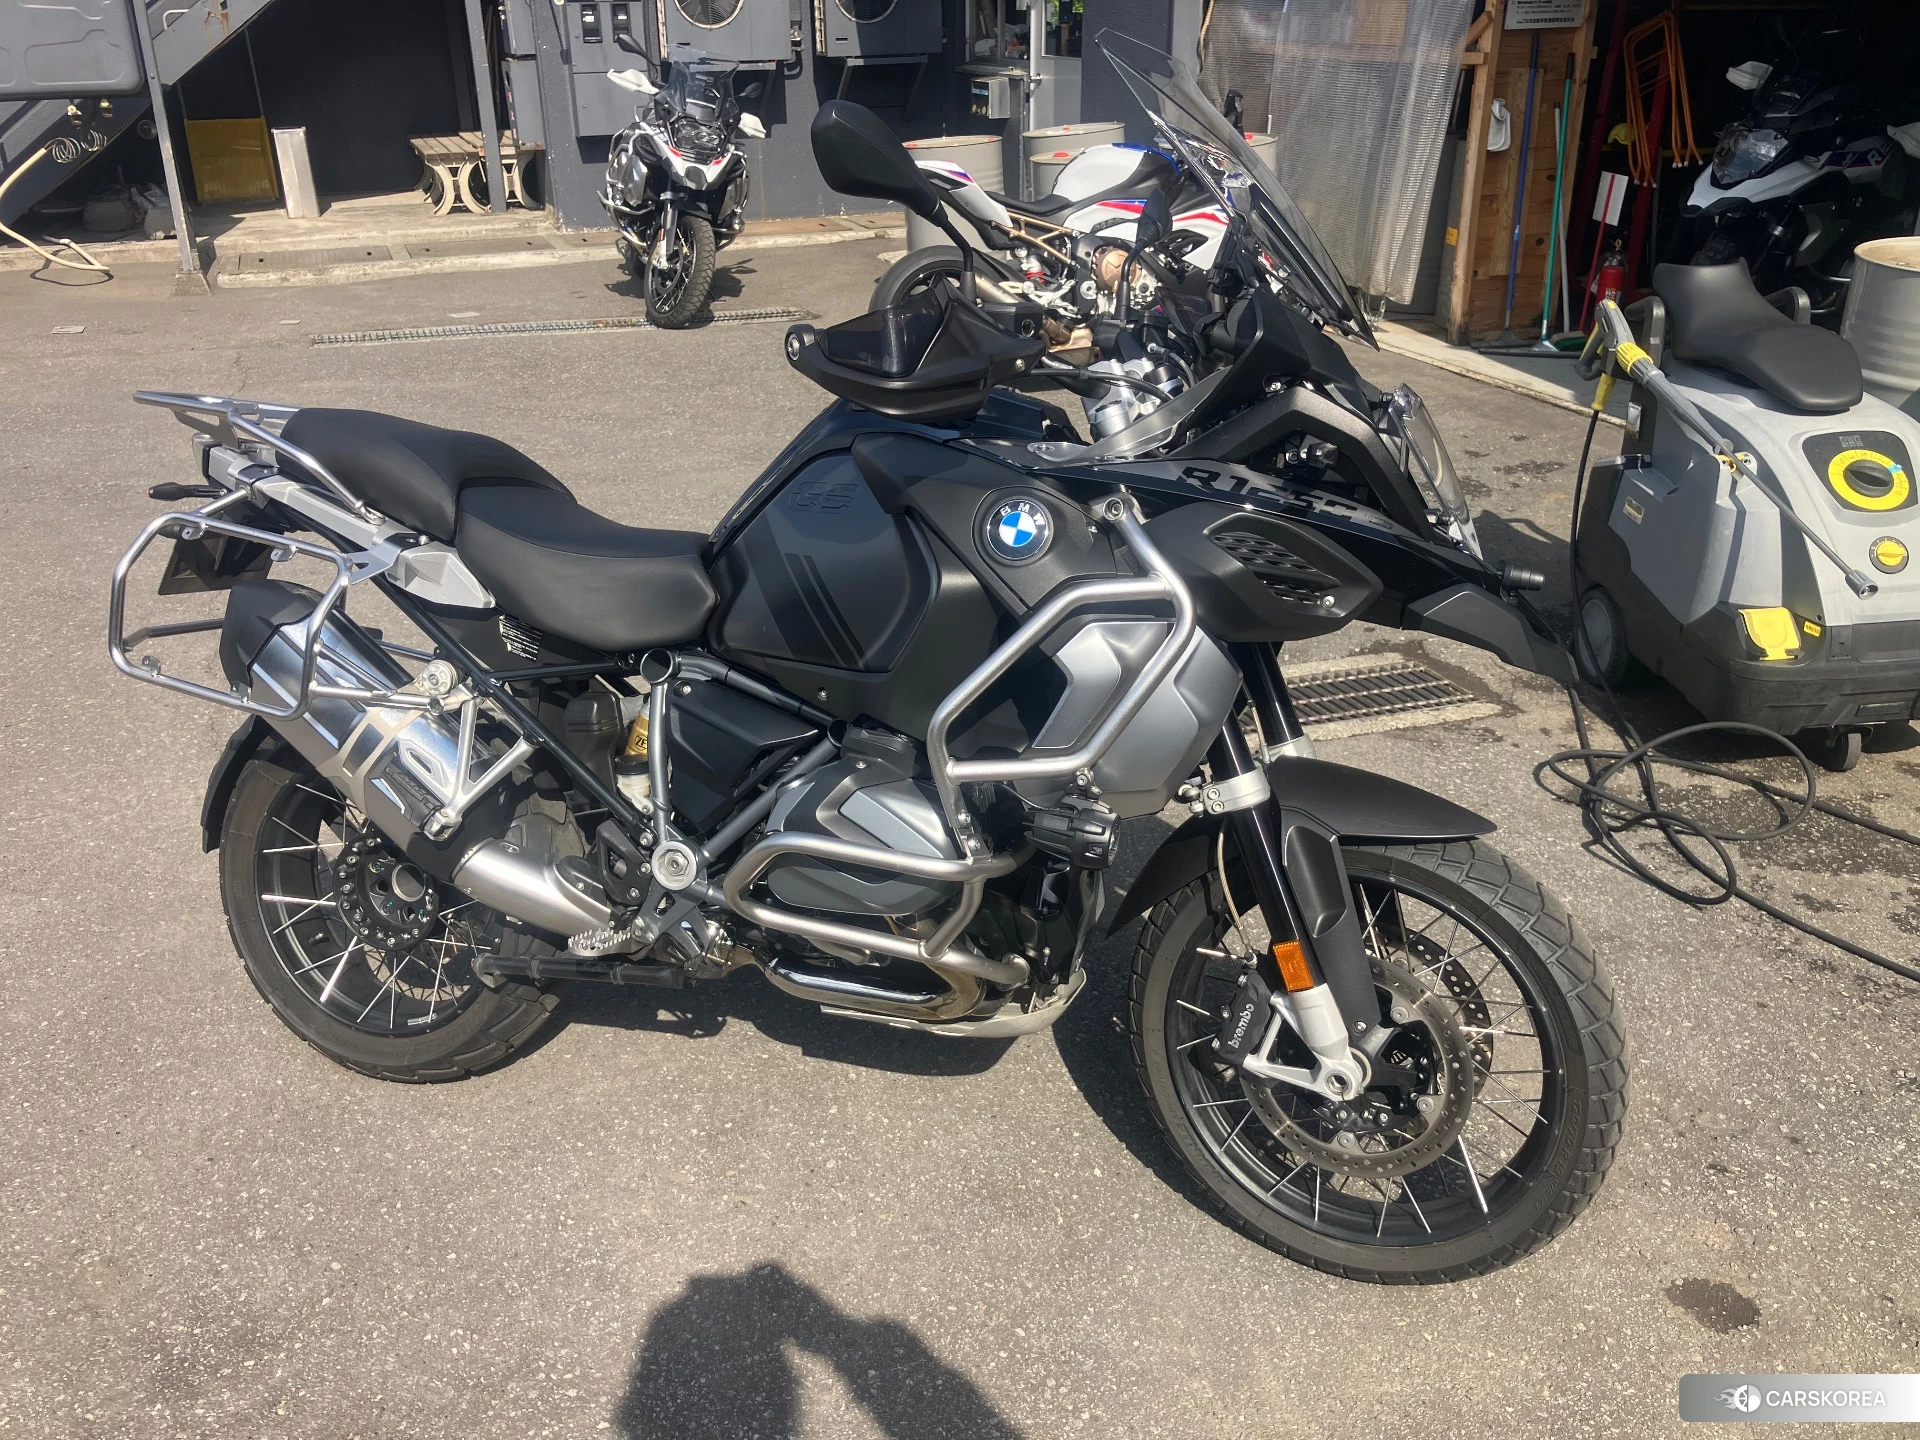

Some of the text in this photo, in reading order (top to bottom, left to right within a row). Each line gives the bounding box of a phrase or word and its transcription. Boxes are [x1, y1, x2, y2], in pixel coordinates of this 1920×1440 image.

[788, 481, 861, 515] GS
[1000, 502, 1046, 526] BMW
[1227, 1003, 1255, 1049] brembo
